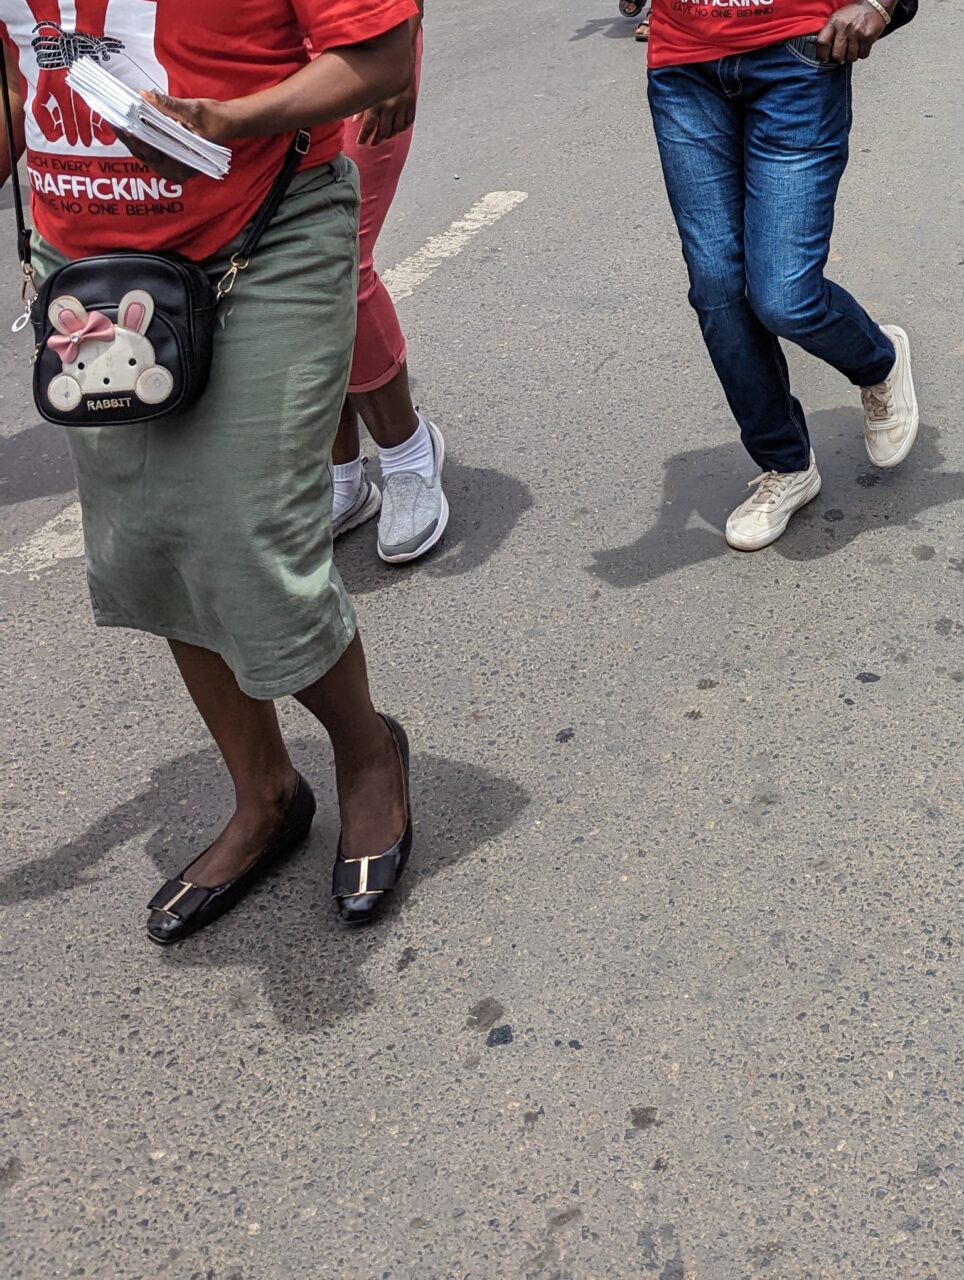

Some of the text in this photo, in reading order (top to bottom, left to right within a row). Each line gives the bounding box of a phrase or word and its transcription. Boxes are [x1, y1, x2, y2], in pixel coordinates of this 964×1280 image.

[696, 6, 708, 17] NO
[711, 9, 733, 18] ONE
[737, 6, 774, 17] BEHIND
[52, 159, 92, 172] EVERY
[98, 161, 149, 173] VICTIM
[27, 167, 183, 201] TRAFFICKING
[61, 201, 184, 216] NO ONE BEHIND
[86, 397, 132, 411] RABBIT
